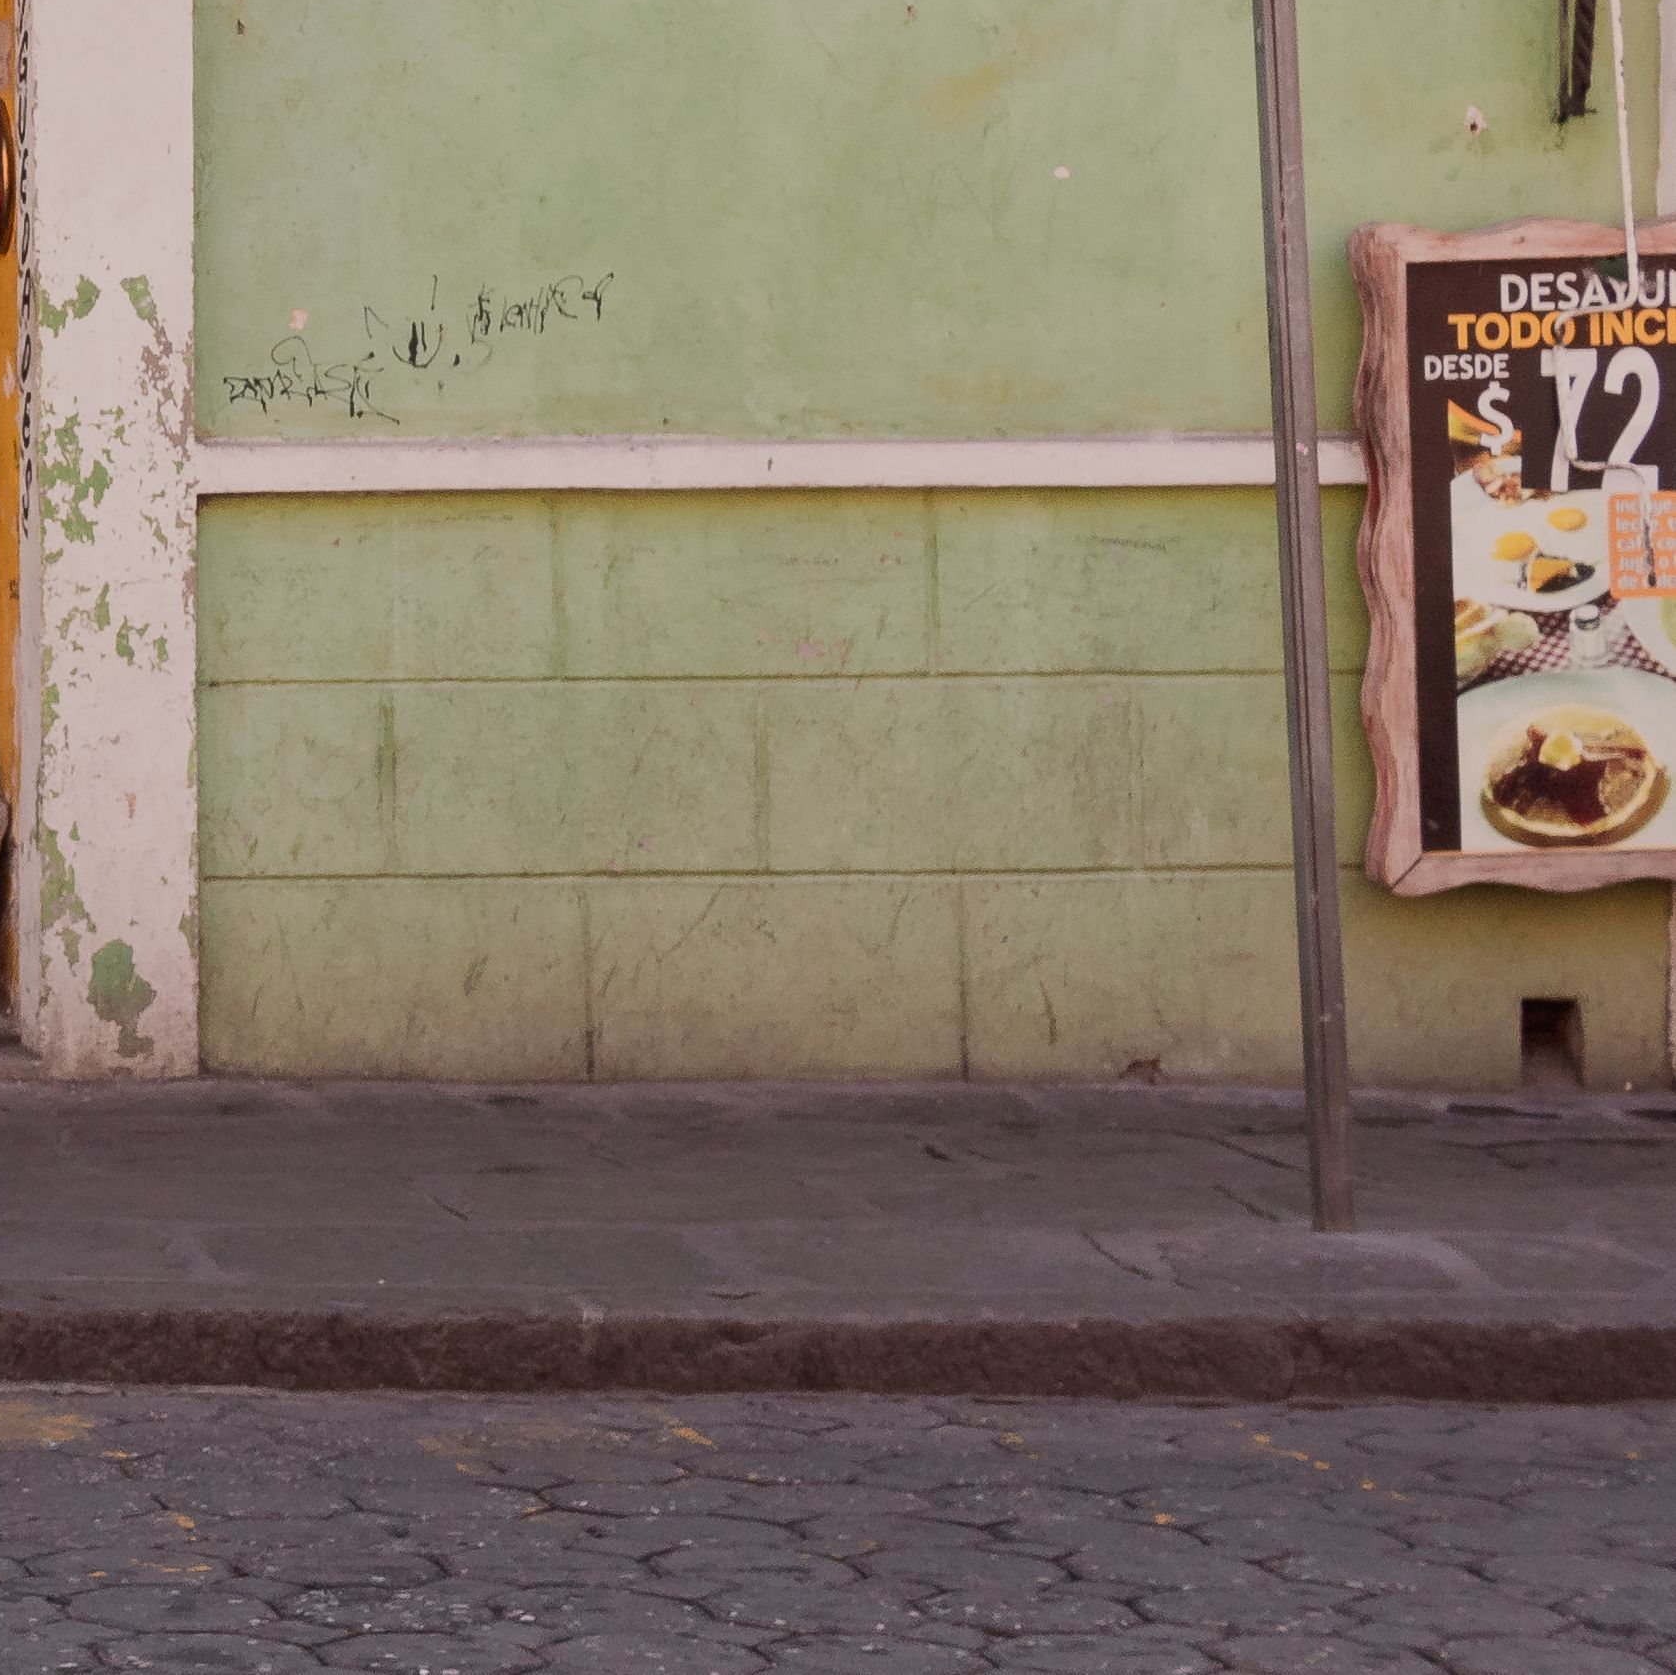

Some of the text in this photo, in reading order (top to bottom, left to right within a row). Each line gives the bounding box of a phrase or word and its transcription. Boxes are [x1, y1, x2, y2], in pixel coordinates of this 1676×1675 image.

[1447, 311, 1577, 351] TODO
[1423, 353, 1510, 381] DESDE
[1476, 346, 1659, 491] $ 72
